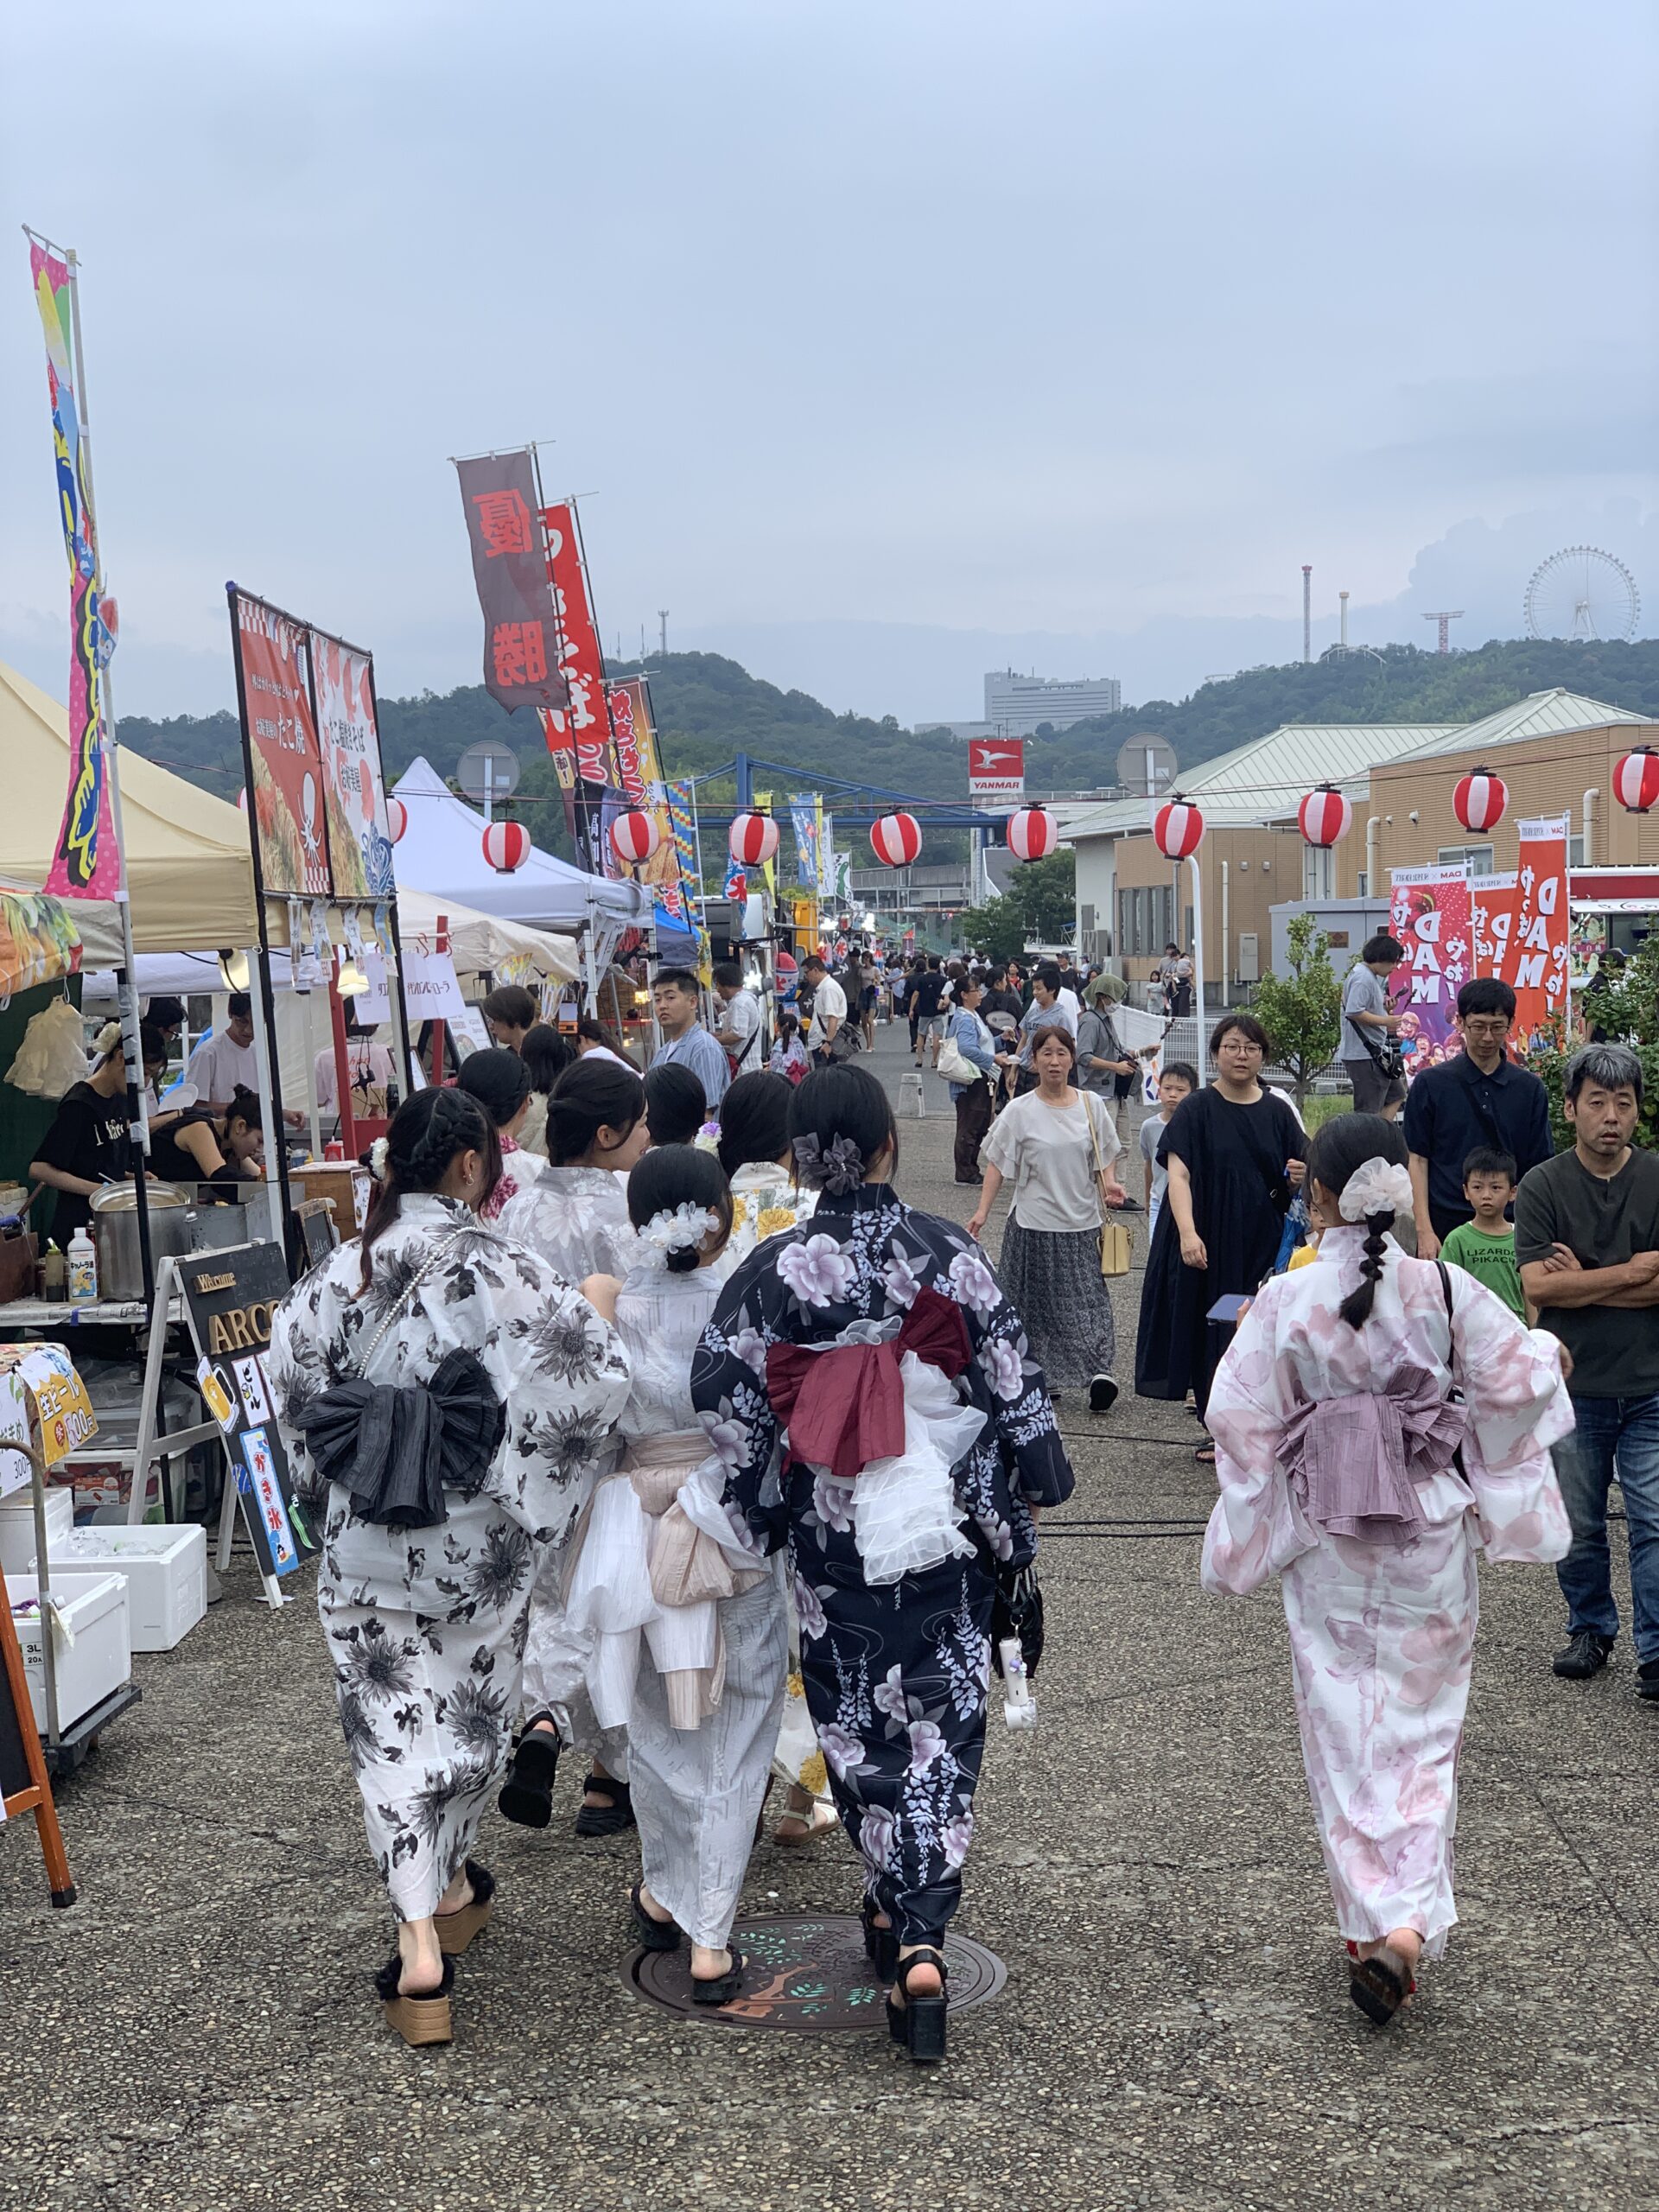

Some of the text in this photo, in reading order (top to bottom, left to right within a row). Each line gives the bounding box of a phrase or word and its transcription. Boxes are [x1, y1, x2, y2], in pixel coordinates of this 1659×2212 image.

[40, 1374, 79, 1422] 生ビール
[254, 1452, 283, 1532] かき氷
[26, 1644, 42, 1653] 3L
